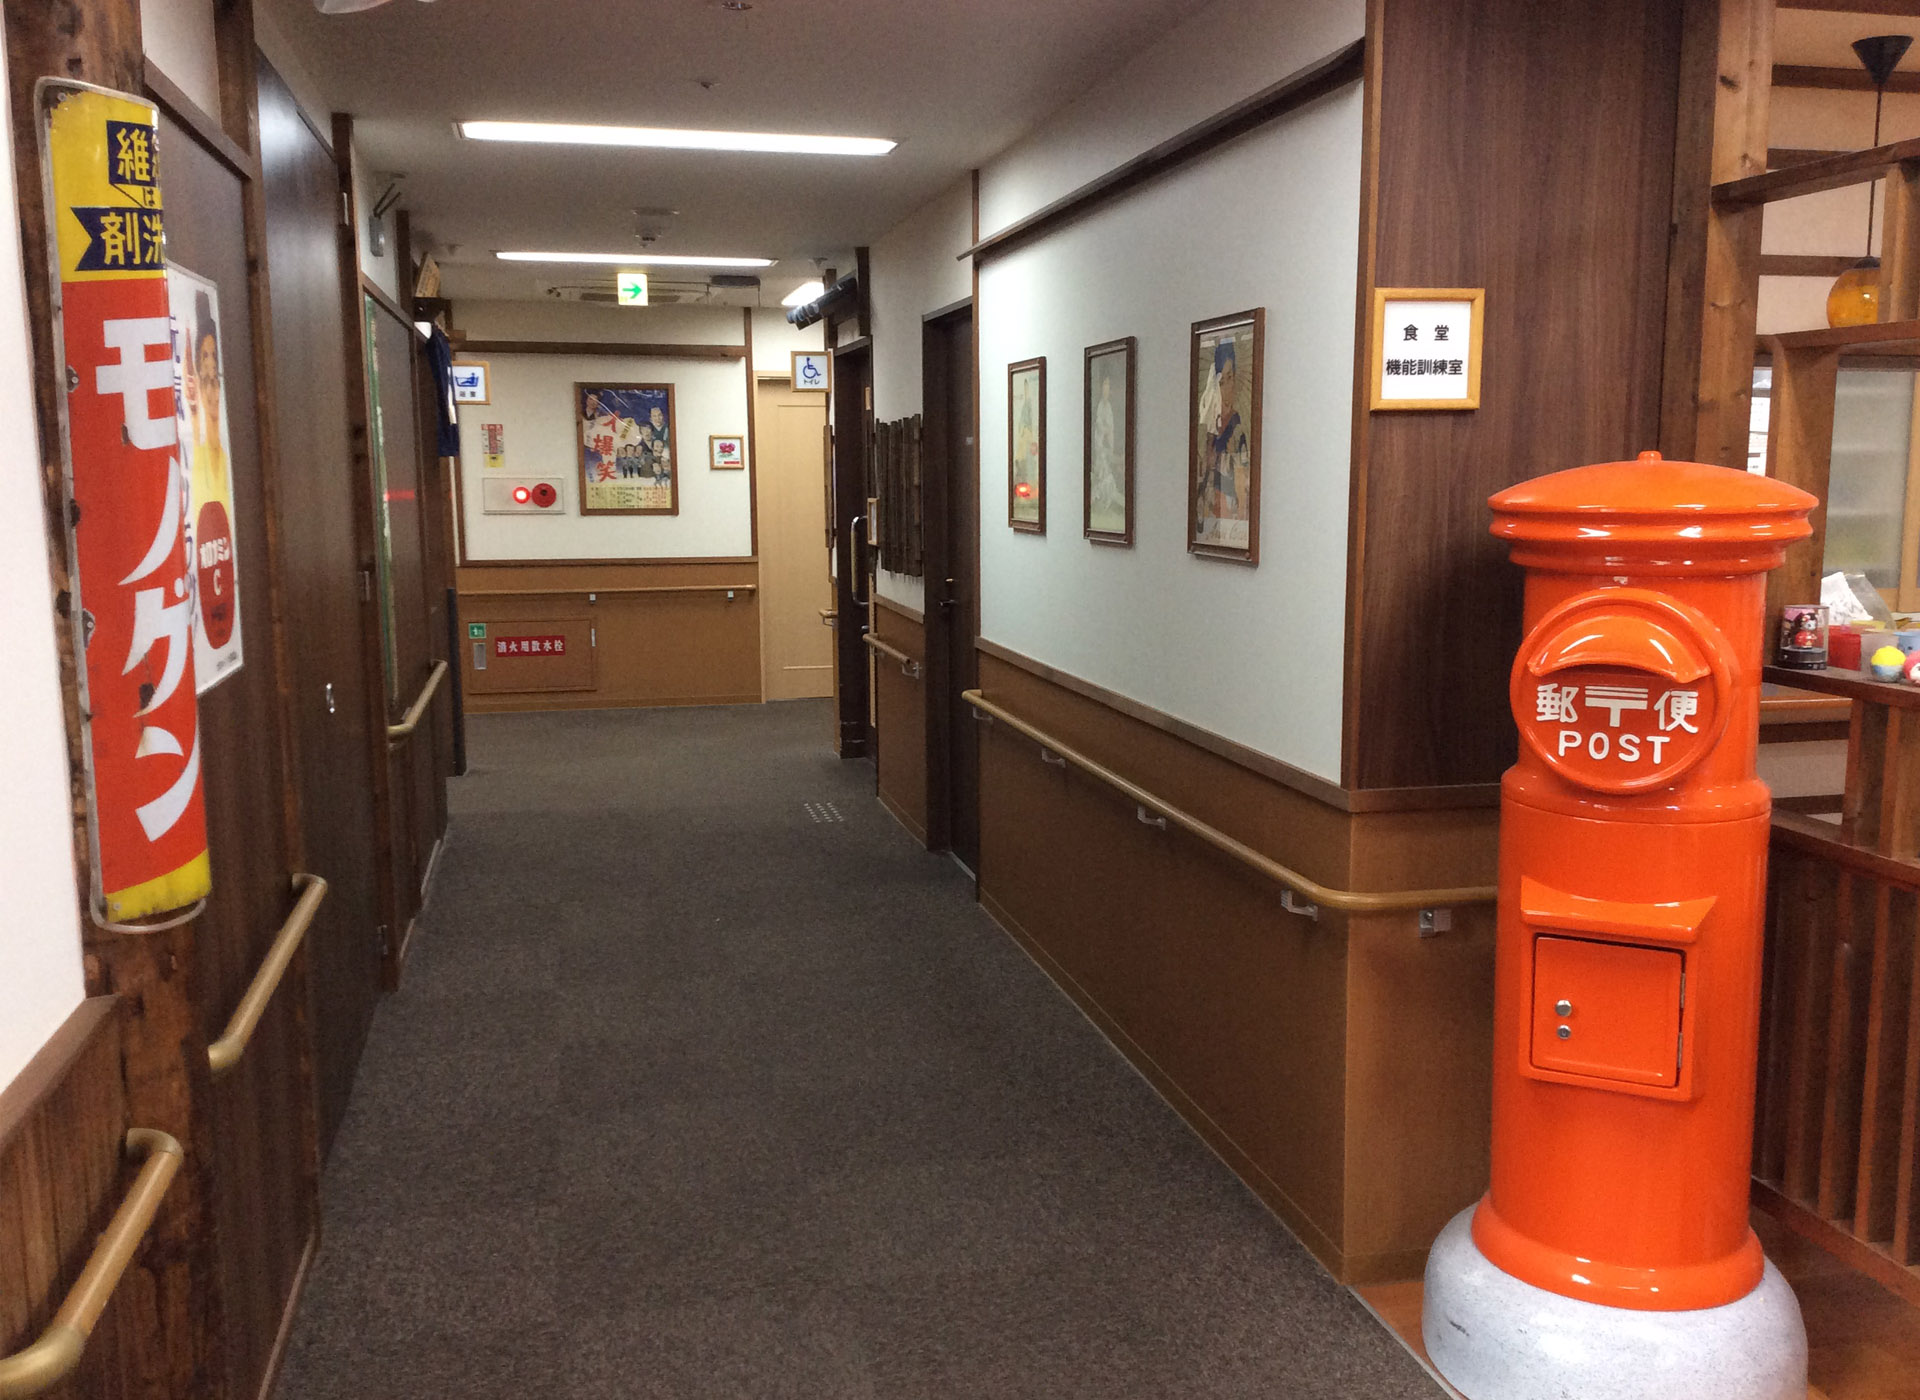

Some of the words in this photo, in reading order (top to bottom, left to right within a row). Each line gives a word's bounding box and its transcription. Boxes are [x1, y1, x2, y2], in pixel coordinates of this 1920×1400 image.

[1386, 359, 1463, 376] 機能訓練室
[497, 639, 564, 653] 消火用散水栓
[1558, 730, 1670, 765] POST
